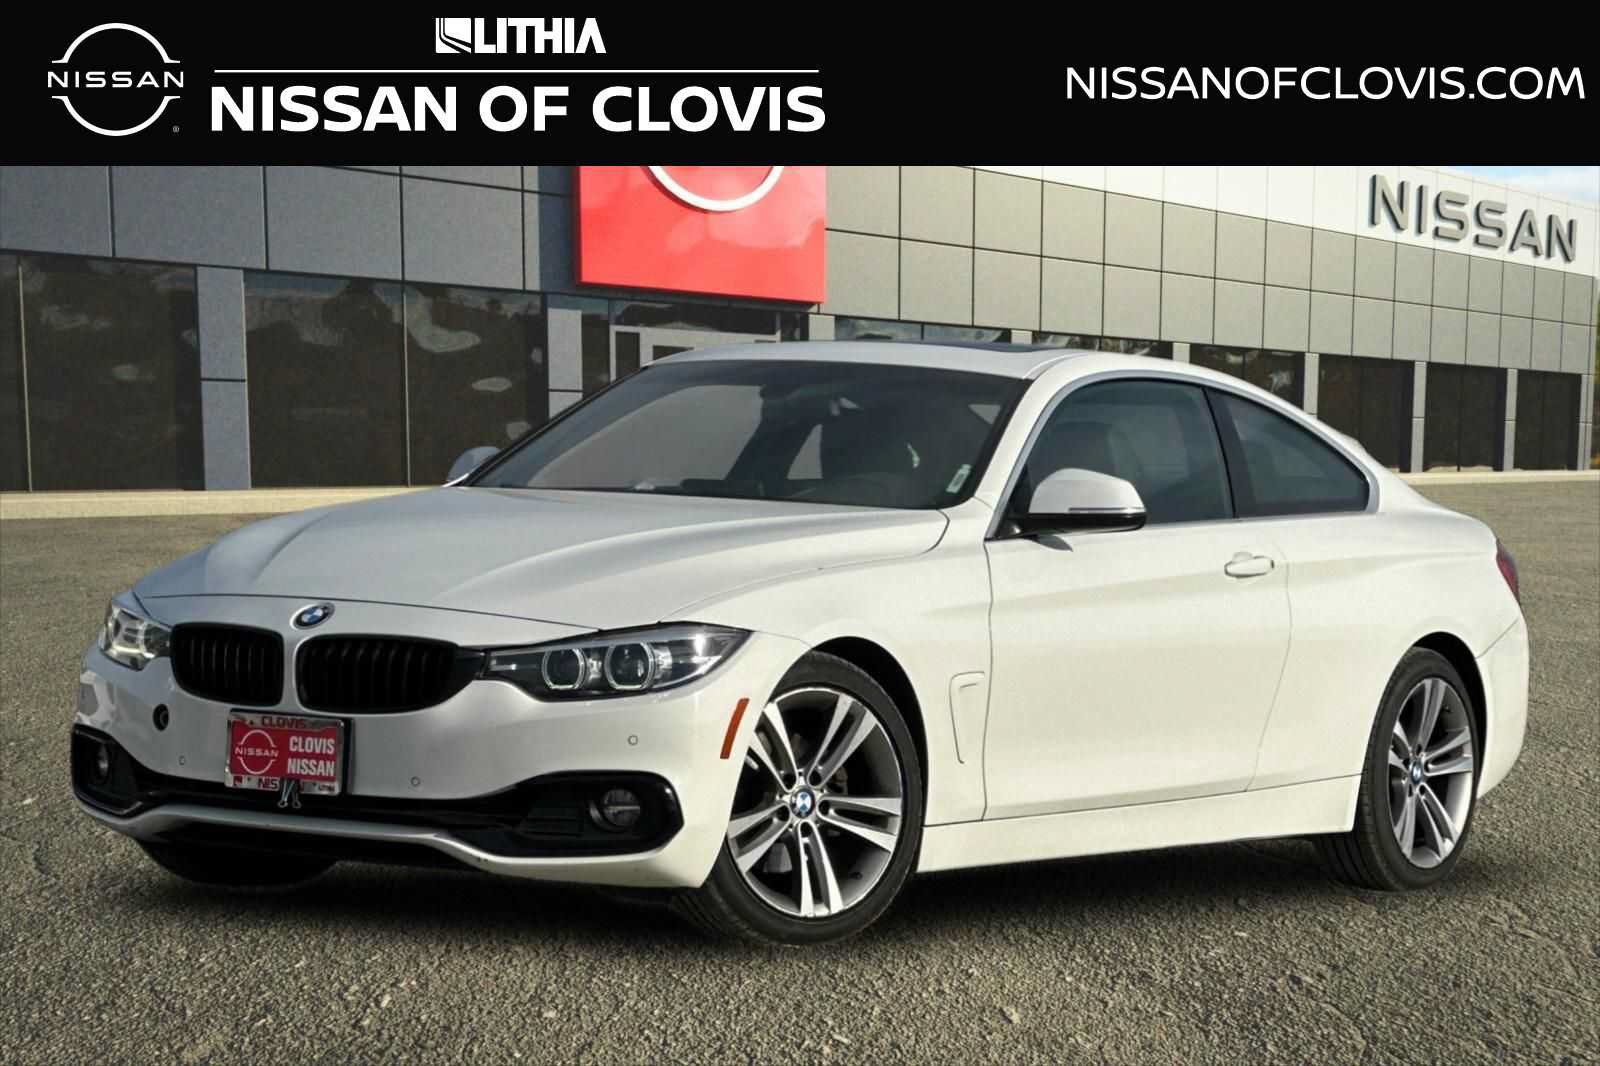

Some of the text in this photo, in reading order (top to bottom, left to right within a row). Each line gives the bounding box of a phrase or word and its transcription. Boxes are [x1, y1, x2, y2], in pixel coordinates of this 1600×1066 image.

[1369, 174, 1577, 263] NISSAN
[234, 746, 279, 758] NISSAN
[289, 735, 335, 754] CLOVIS
[287, 758, 335, 777] NISSAN
